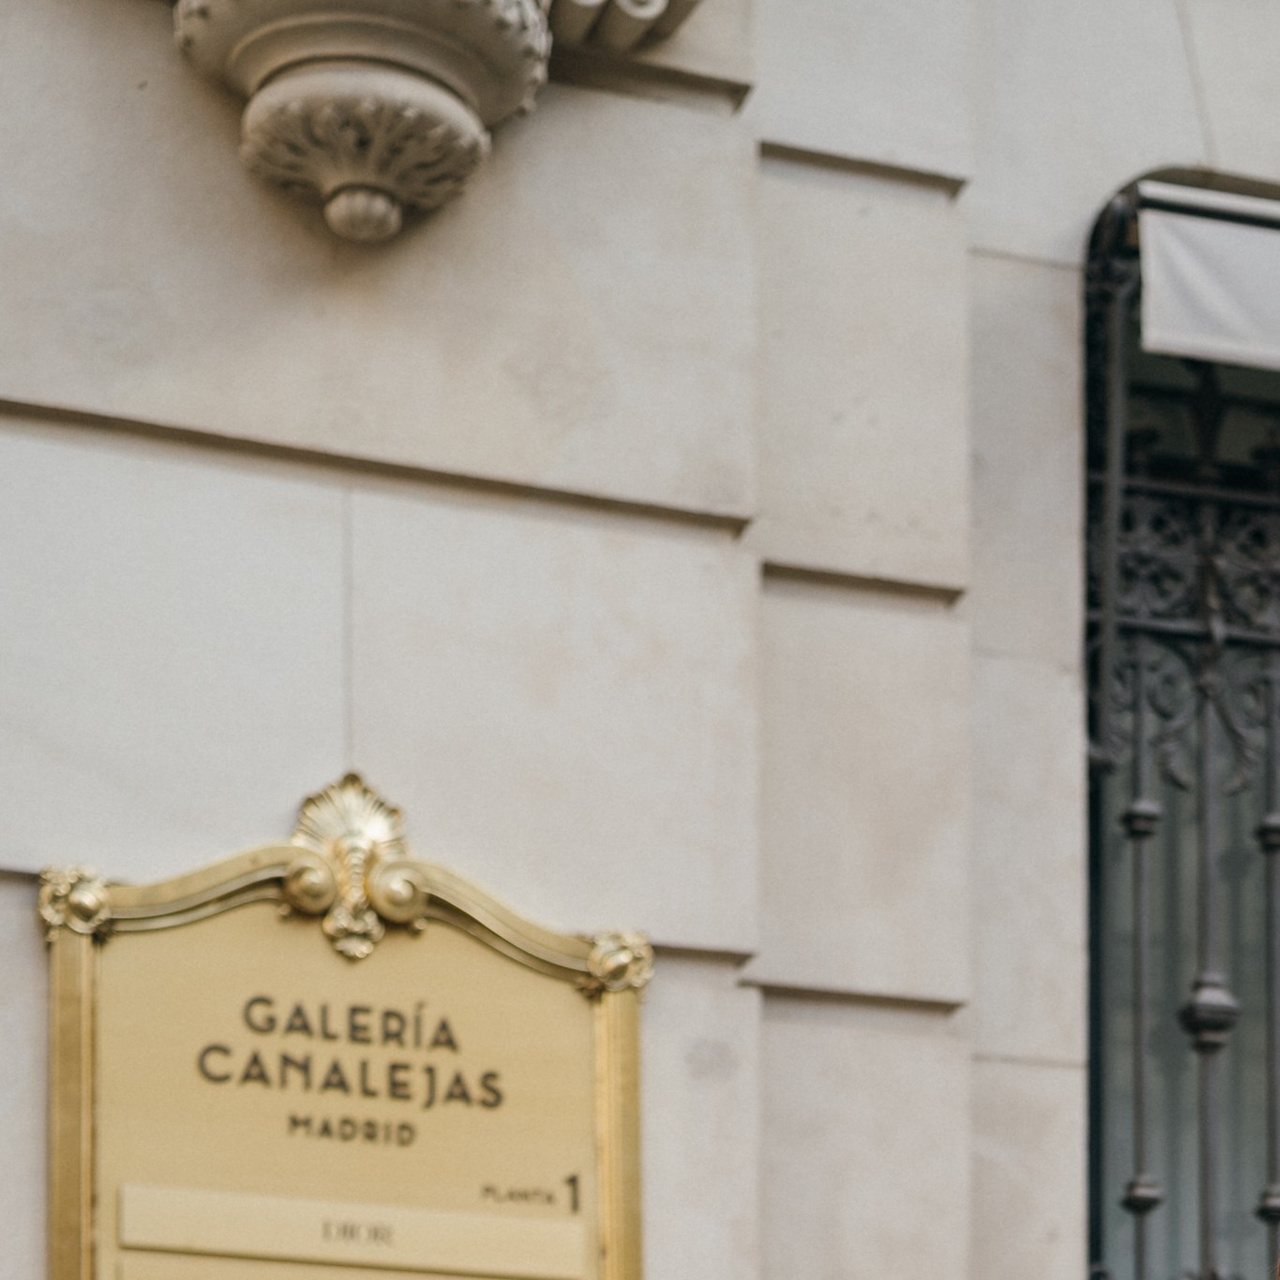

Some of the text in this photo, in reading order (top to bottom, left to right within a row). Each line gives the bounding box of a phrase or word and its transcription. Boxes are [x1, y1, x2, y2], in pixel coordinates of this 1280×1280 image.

[243, 996, 459, 1052] GALERÍA
[198, 1044, 504, 1109] CANALEJAS
[288, 1114, 416, 1146] MADRID
[565, 1173, 580, 1214] 1
